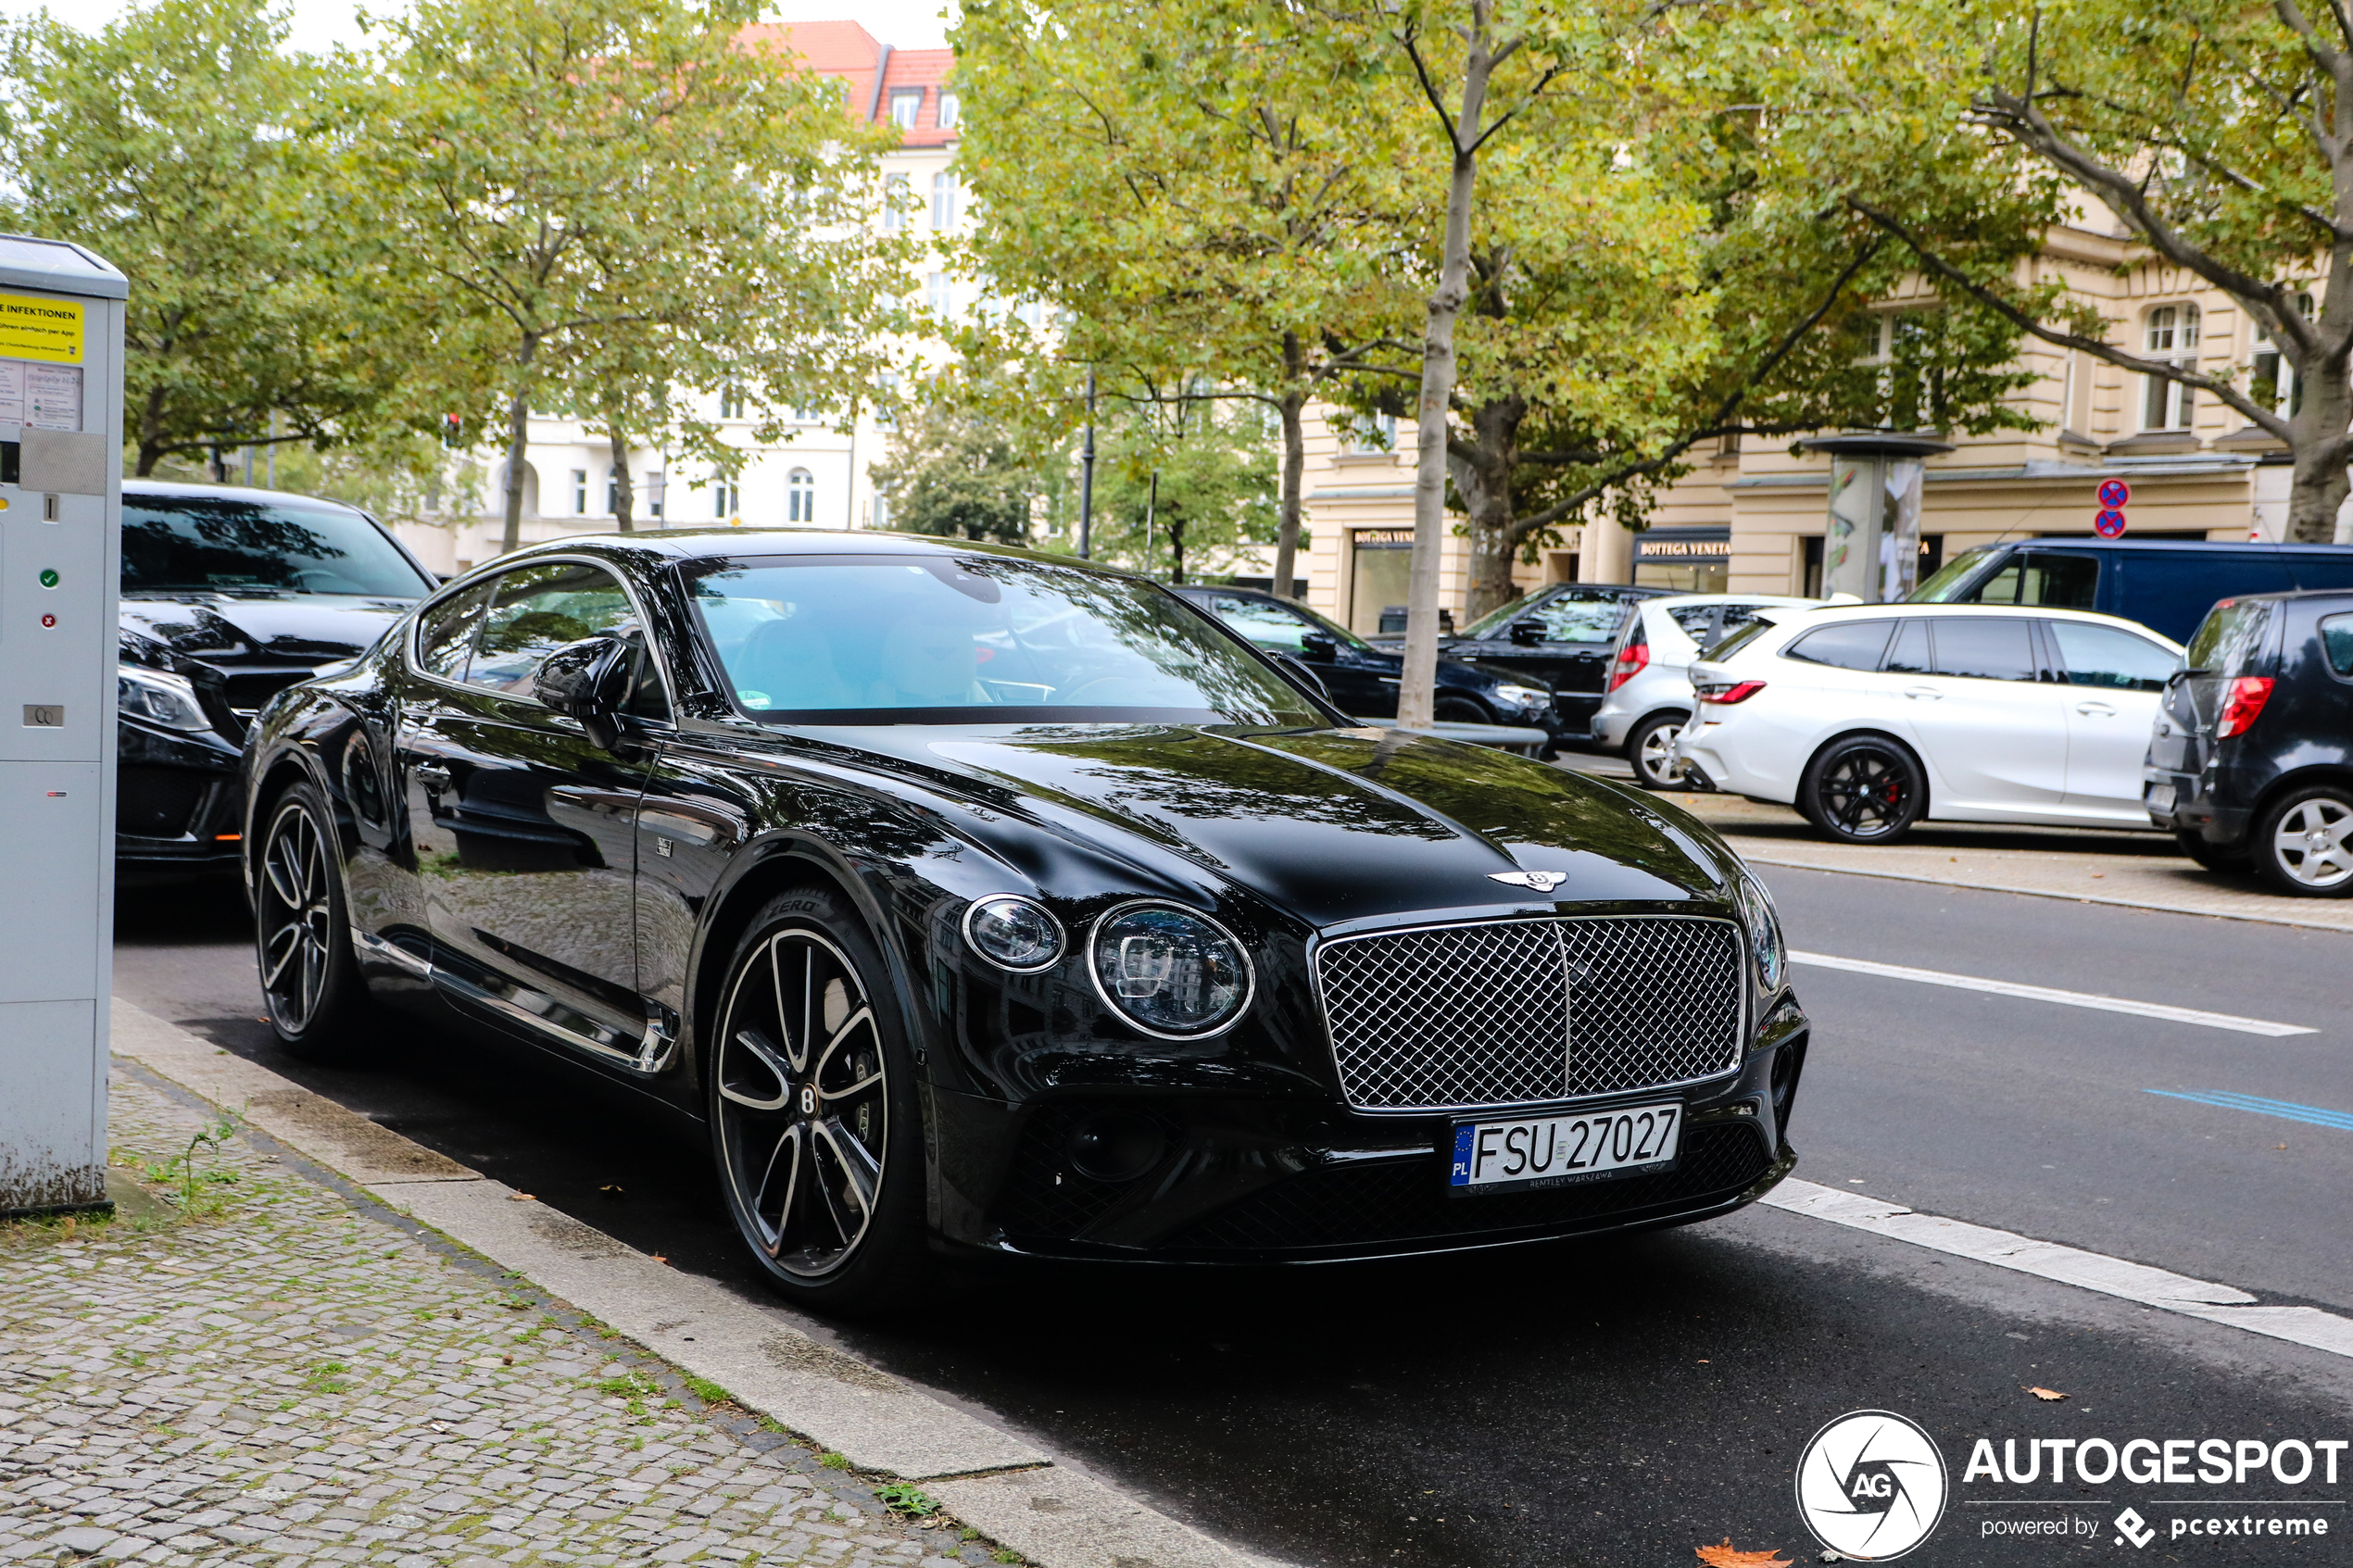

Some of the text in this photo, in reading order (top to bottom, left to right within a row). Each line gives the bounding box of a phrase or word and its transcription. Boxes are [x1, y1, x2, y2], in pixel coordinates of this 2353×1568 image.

[6, 304, 76, 320] INFEKTIONEN
[1354, 531, 1392, 543] BOTTEGA
[1641, 542, 1731, 556] BOTTEGA VENETA
[767, 899, 817, 920] ZERO
[1452, 1108, 1678, 1179] PL FSU 27027
[1529, 1171, 1613, 1187] BENTLEY WARSZAWA
